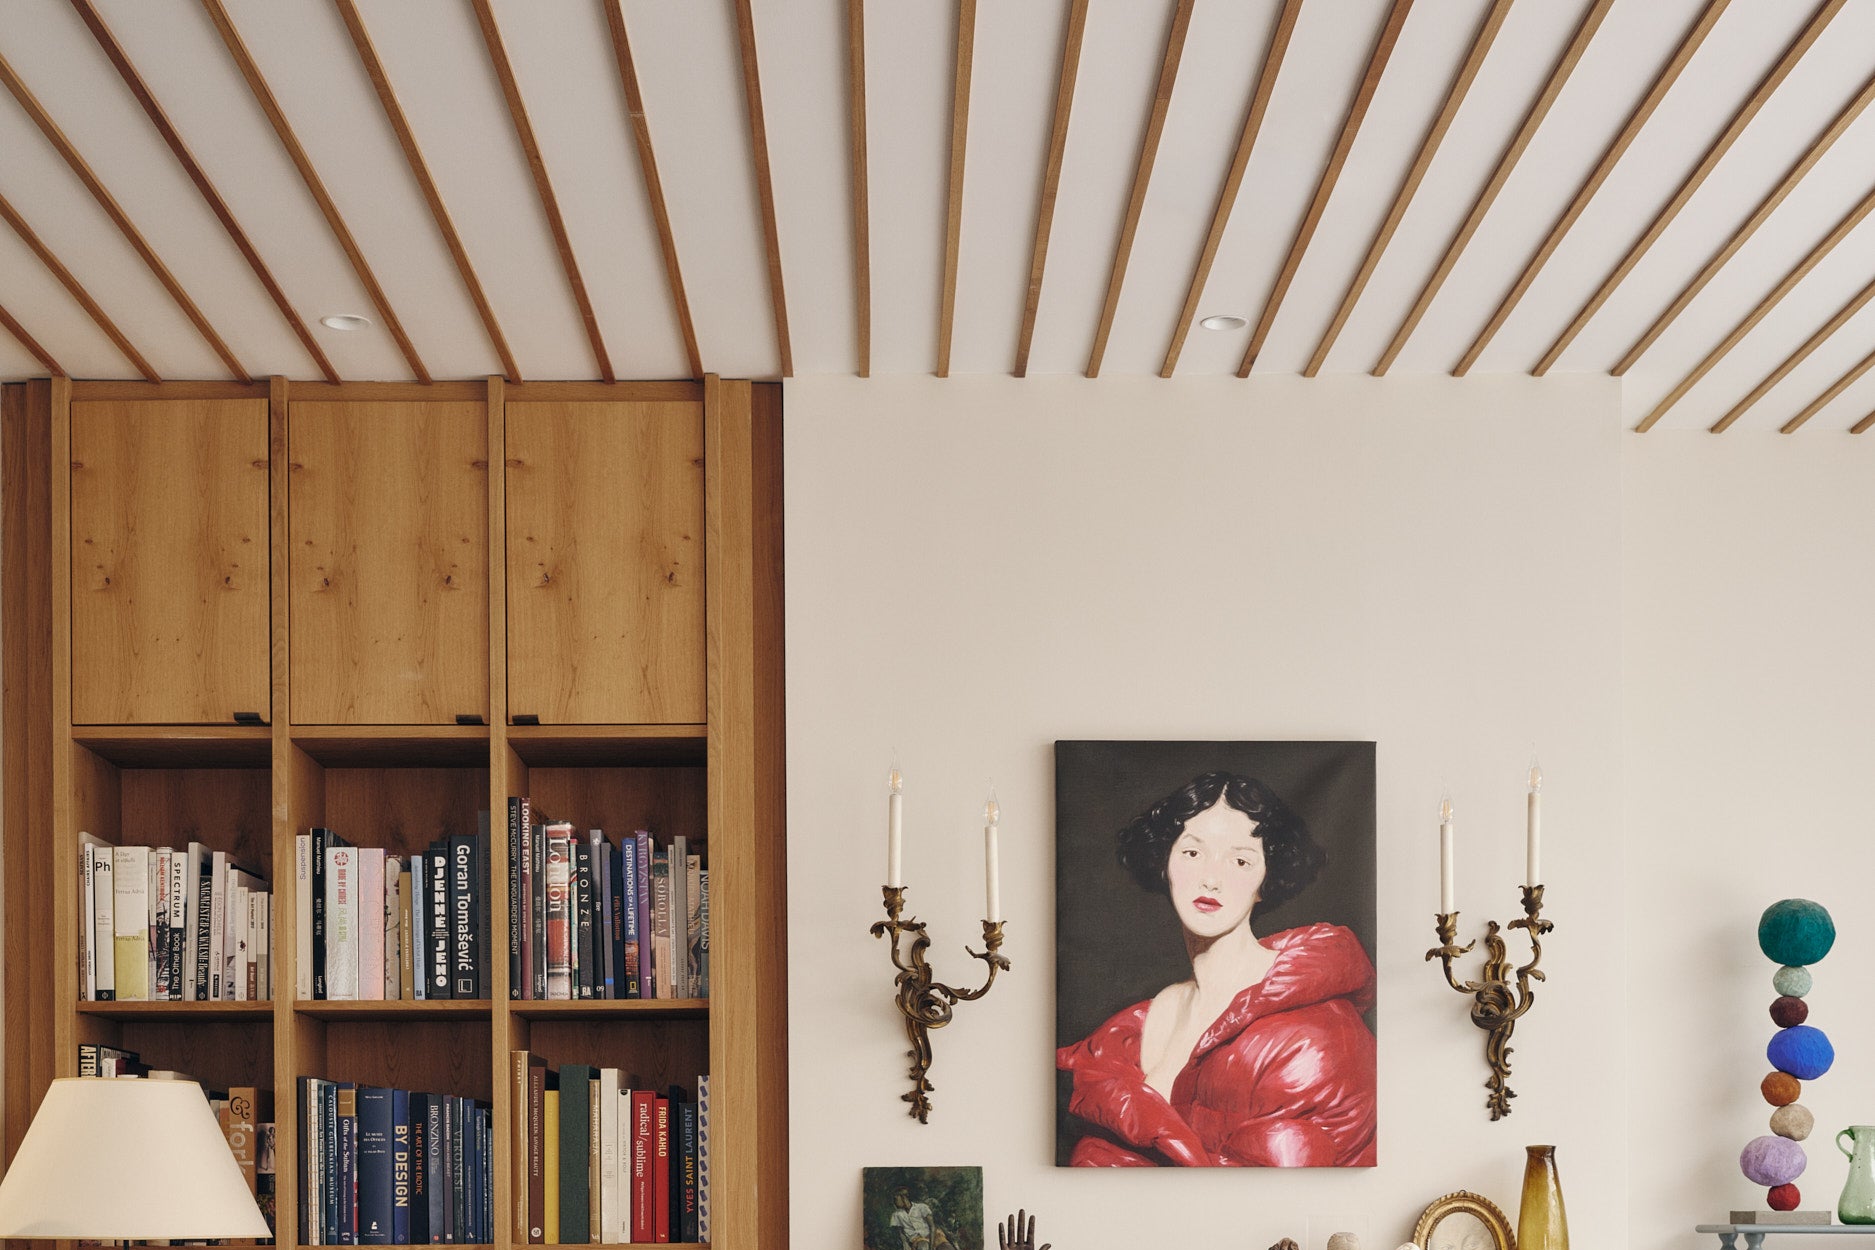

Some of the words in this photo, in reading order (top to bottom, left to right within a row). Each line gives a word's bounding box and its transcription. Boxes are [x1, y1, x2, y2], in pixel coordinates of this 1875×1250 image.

[95, 862, 111, 872] Ph
[456, 844, 470, 890] Goran
[550, 838, 569, 912] London
[626, 844, 634, 896] DESTINATIONS
[638, 834, 648, 905] KYRGYZSTAN
[200, 881, 210, 927] SAGMEISTER
[579, 854, 590, 927] BRONZE
[656, 878, 669, 934] SOROLLA
[700, 872, 708, 912] NOAH
[458, 893, 474, 971] Tomašević
[700, 912, 708, 950] DAVIS
[80, 1045, 97, 1077] AFTER
[395, 1125, 408, 1144] BY
[430, 1105, 438, 1156] BRONZINO
[658, 1106, 666, 1128] FRIDA
[684, 1108, 692, 1154] LAURENT
[416, 1150, 422, 1158] OF
[454, 1130, 462, 1192] VERONESE
[658, 1131, 666, 1157] KAHLO
[395, 1152, 408, 1207] DESIGN
